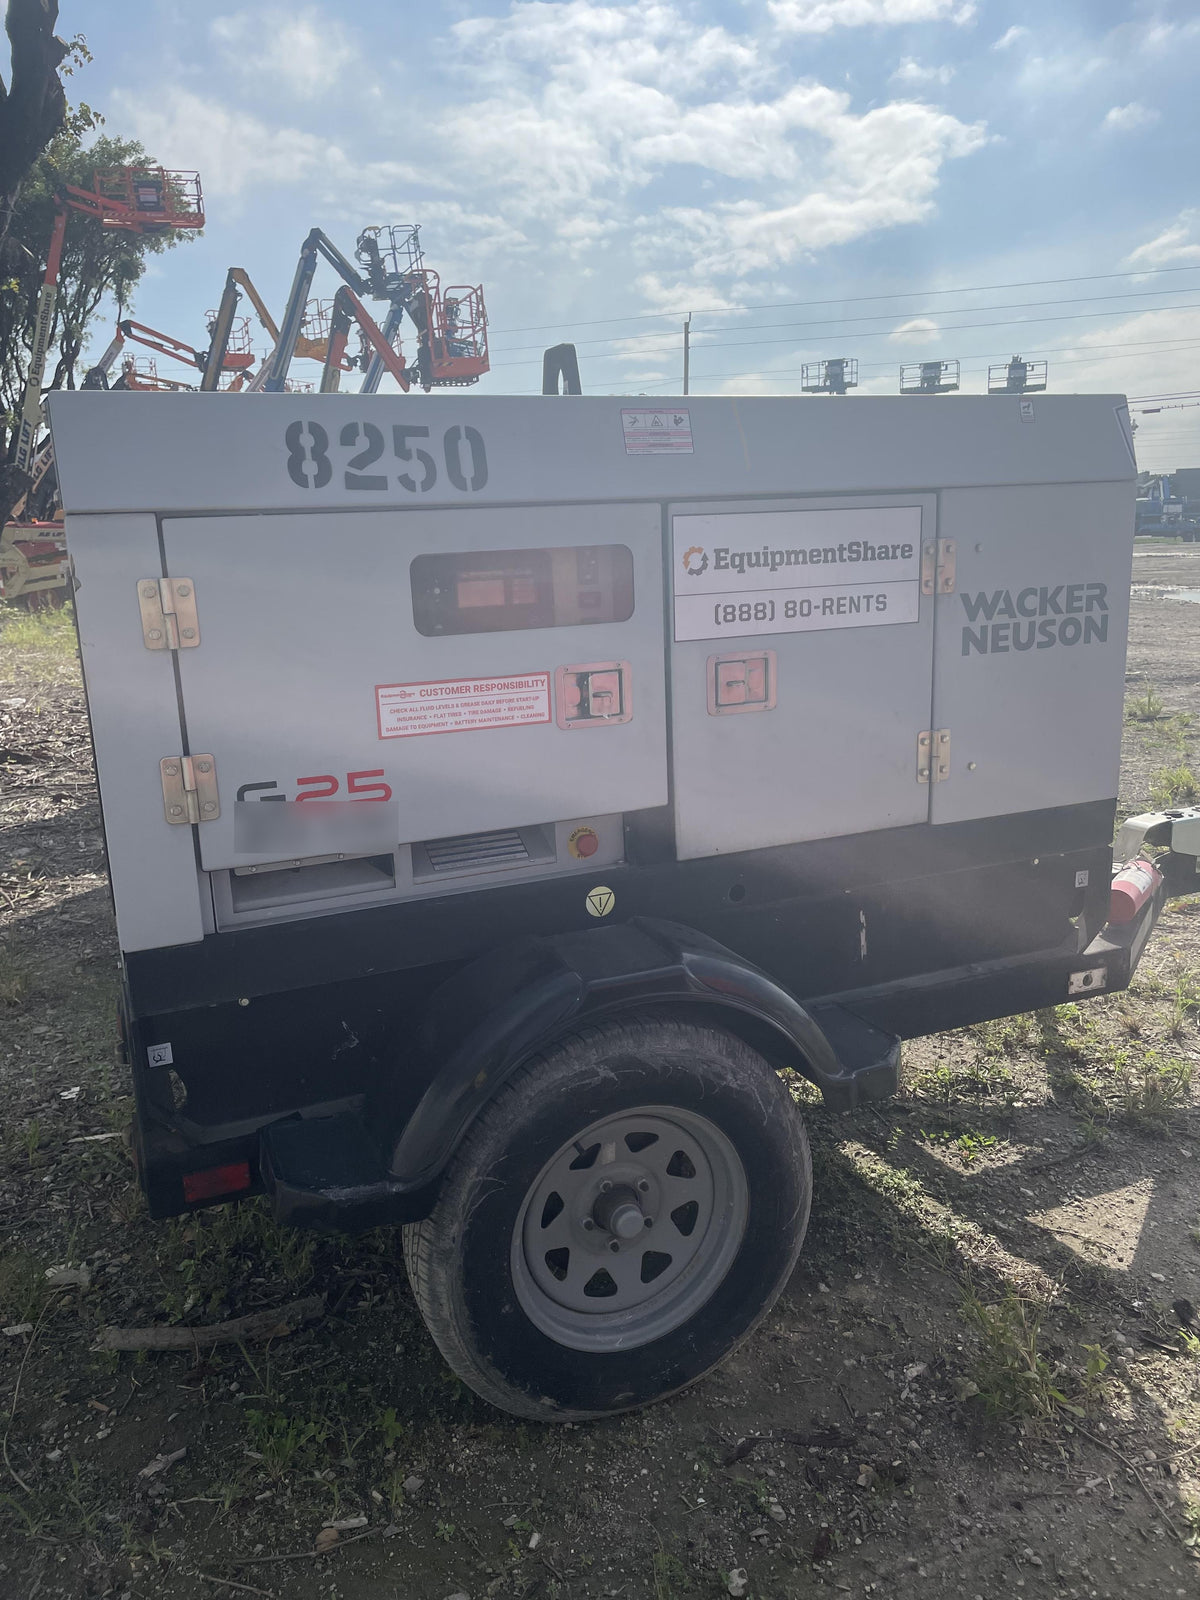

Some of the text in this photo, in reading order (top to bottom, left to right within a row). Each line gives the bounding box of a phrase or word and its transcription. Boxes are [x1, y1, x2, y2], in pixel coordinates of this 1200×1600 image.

[31, 292, 52, 376] EquipmentShare
[20, 418, 32, 446] LIFT
[285, 420, 489, 493] 8250
[713, 540, 914, 574] EquipmentShare
[714, 593, 888, 625] (888) 80-RENTS
[959, 582, 1109, 622] WACKER
[961, 614, 1109, 656] NEUSON
[419, 685, 471, 697] CUSTOMER
[473, 679, 546, 693] RESPONSIBILITY
[436, 703, 455, 711] LEVELS
[461, 700, 480, 708] GREASE
[516, 695, 540, 703] START-UP
[397, 714, 427, 722] INSURANCE
[480, 707, 502, 715] DAMAGE
[507, 704, 535, 712] REFUELING
[418, 721, 448, 730] EQUIPMENT
[454, 718, 477, 726] BATTERY
[478, 715, 515, 723] MAINTENANCE
[520, 712, 545, 720] CLEANING
